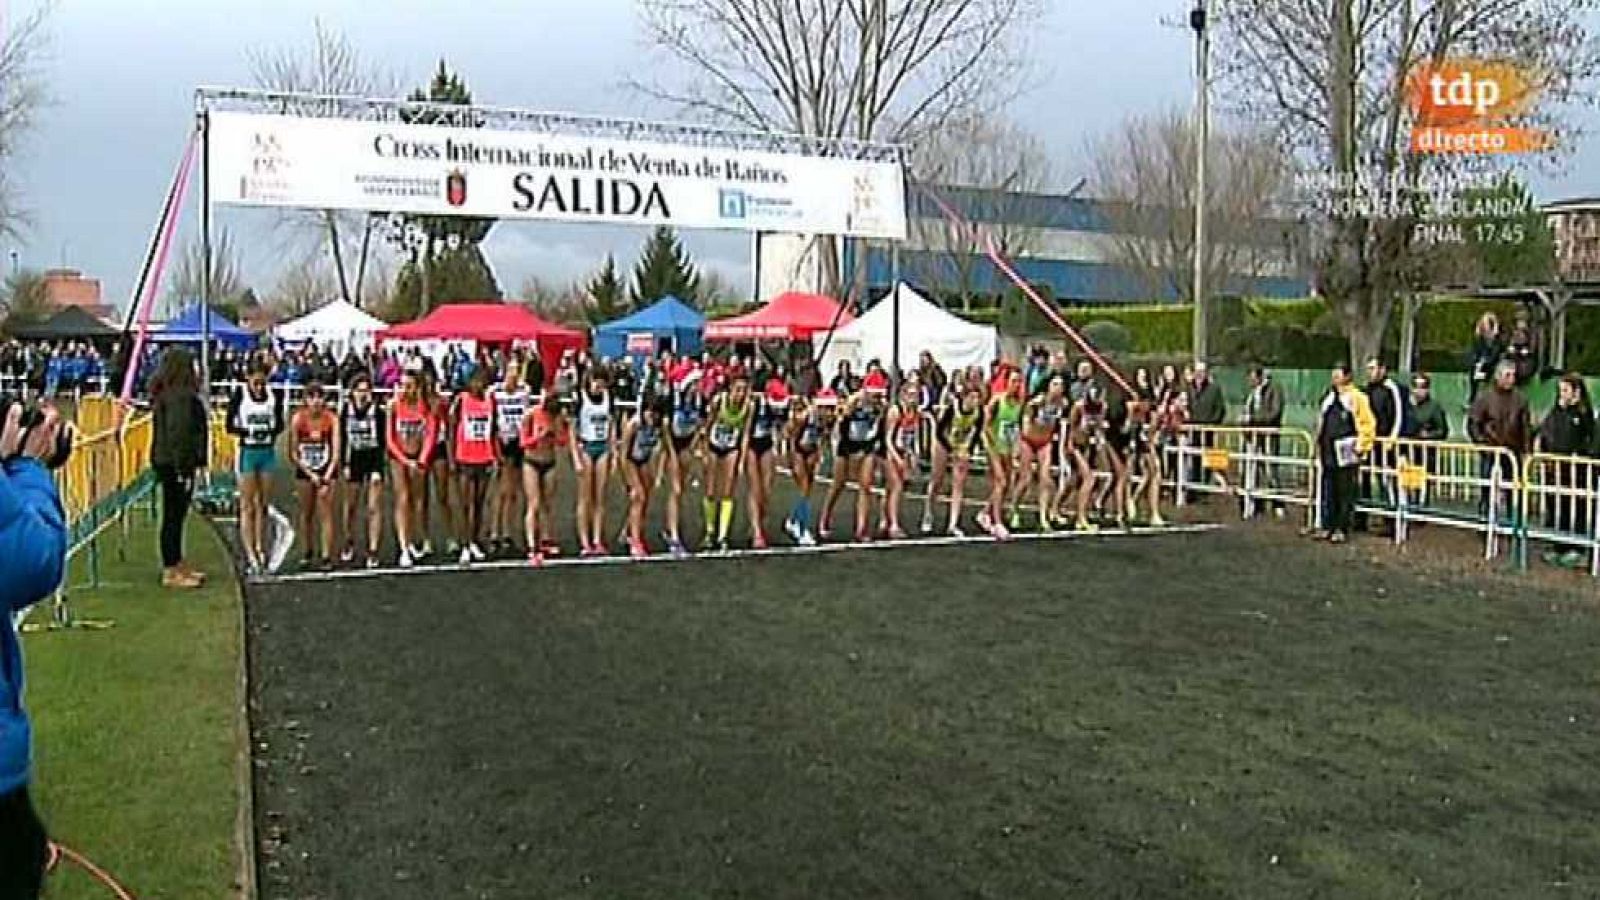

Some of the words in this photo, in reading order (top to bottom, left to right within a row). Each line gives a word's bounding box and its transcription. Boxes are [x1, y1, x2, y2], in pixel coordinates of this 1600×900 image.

[373, 133, 441, 160] Cross
[446, 137, 594, 171] Internacional
[600, 148, 627, 173] de
[627, 152, 690, 178] Venta
[694, 156, 721, 180] de
[512, 172, 671, 219] SALIDA
